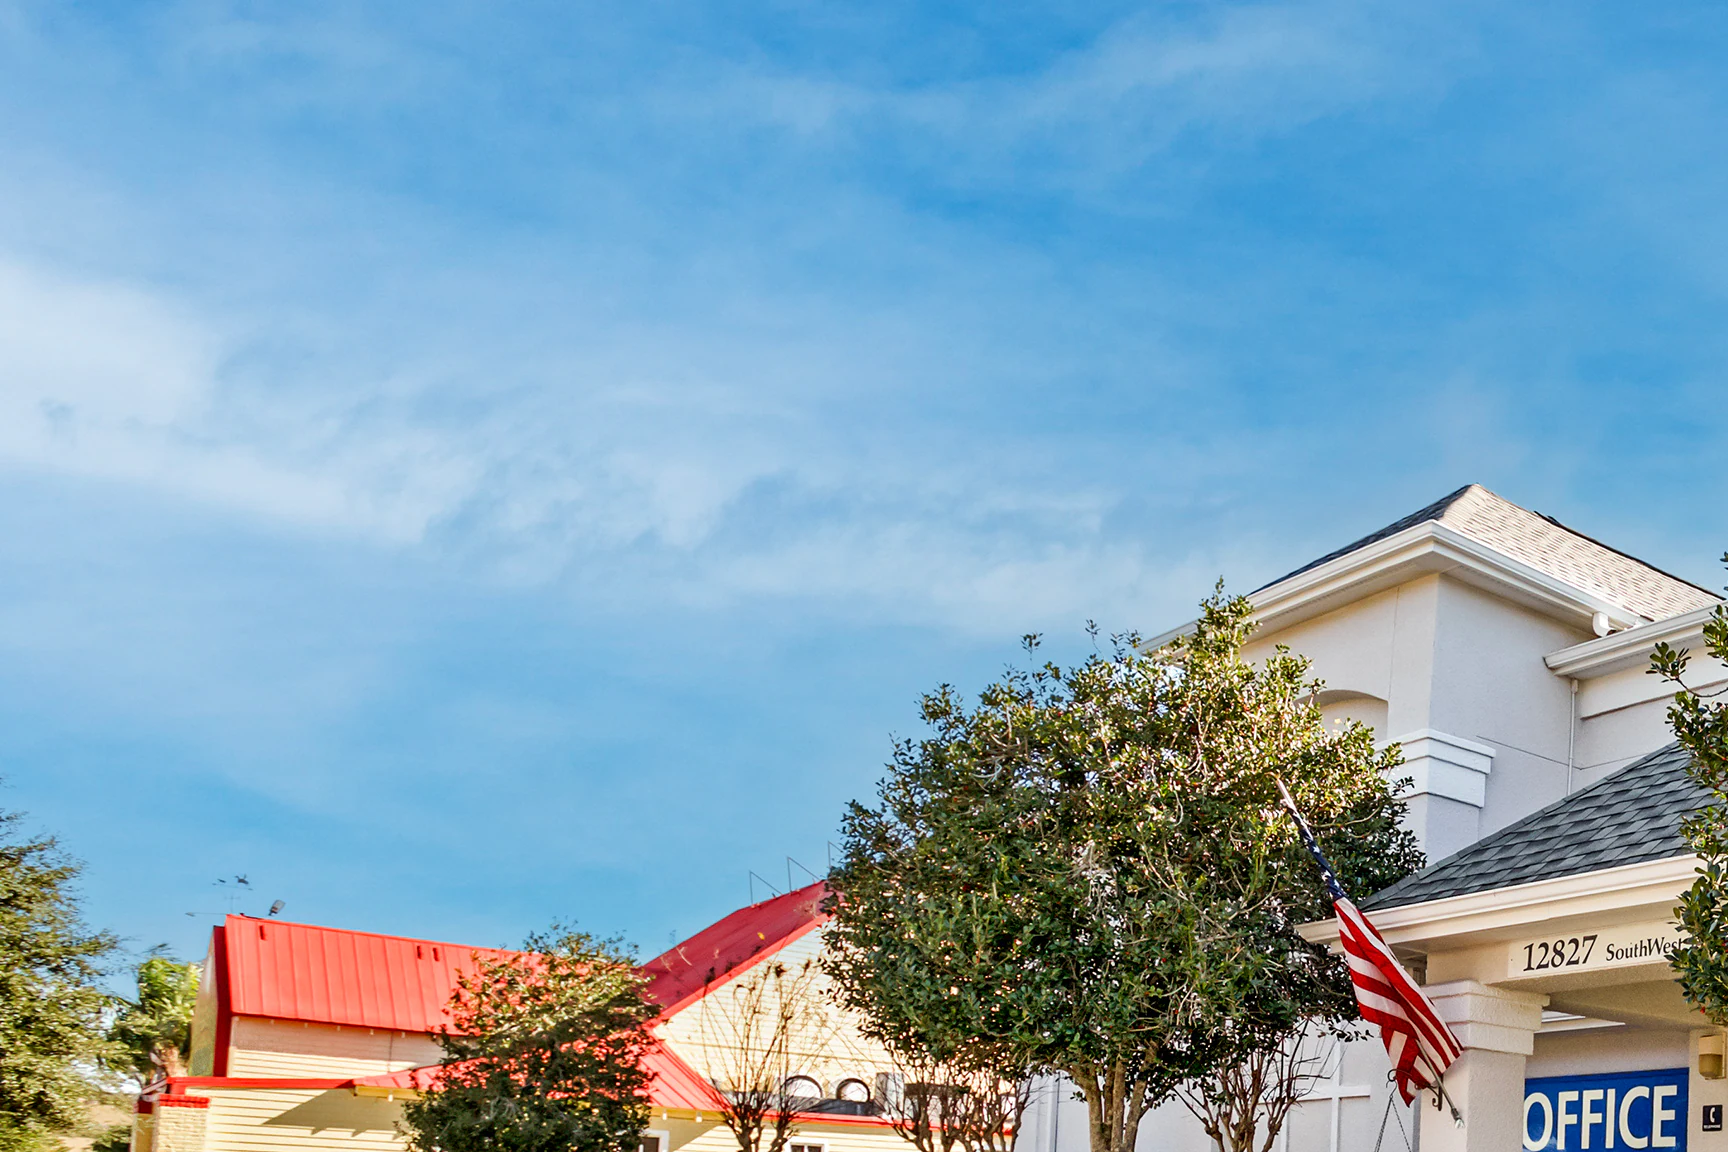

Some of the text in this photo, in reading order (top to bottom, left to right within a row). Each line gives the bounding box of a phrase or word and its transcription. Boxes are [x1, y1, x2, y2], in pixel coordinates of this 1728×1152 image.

[1522, 934, 1683, 972] 12827 SouthWest
[1522, 1084, 1678, 1152] OFFICE
